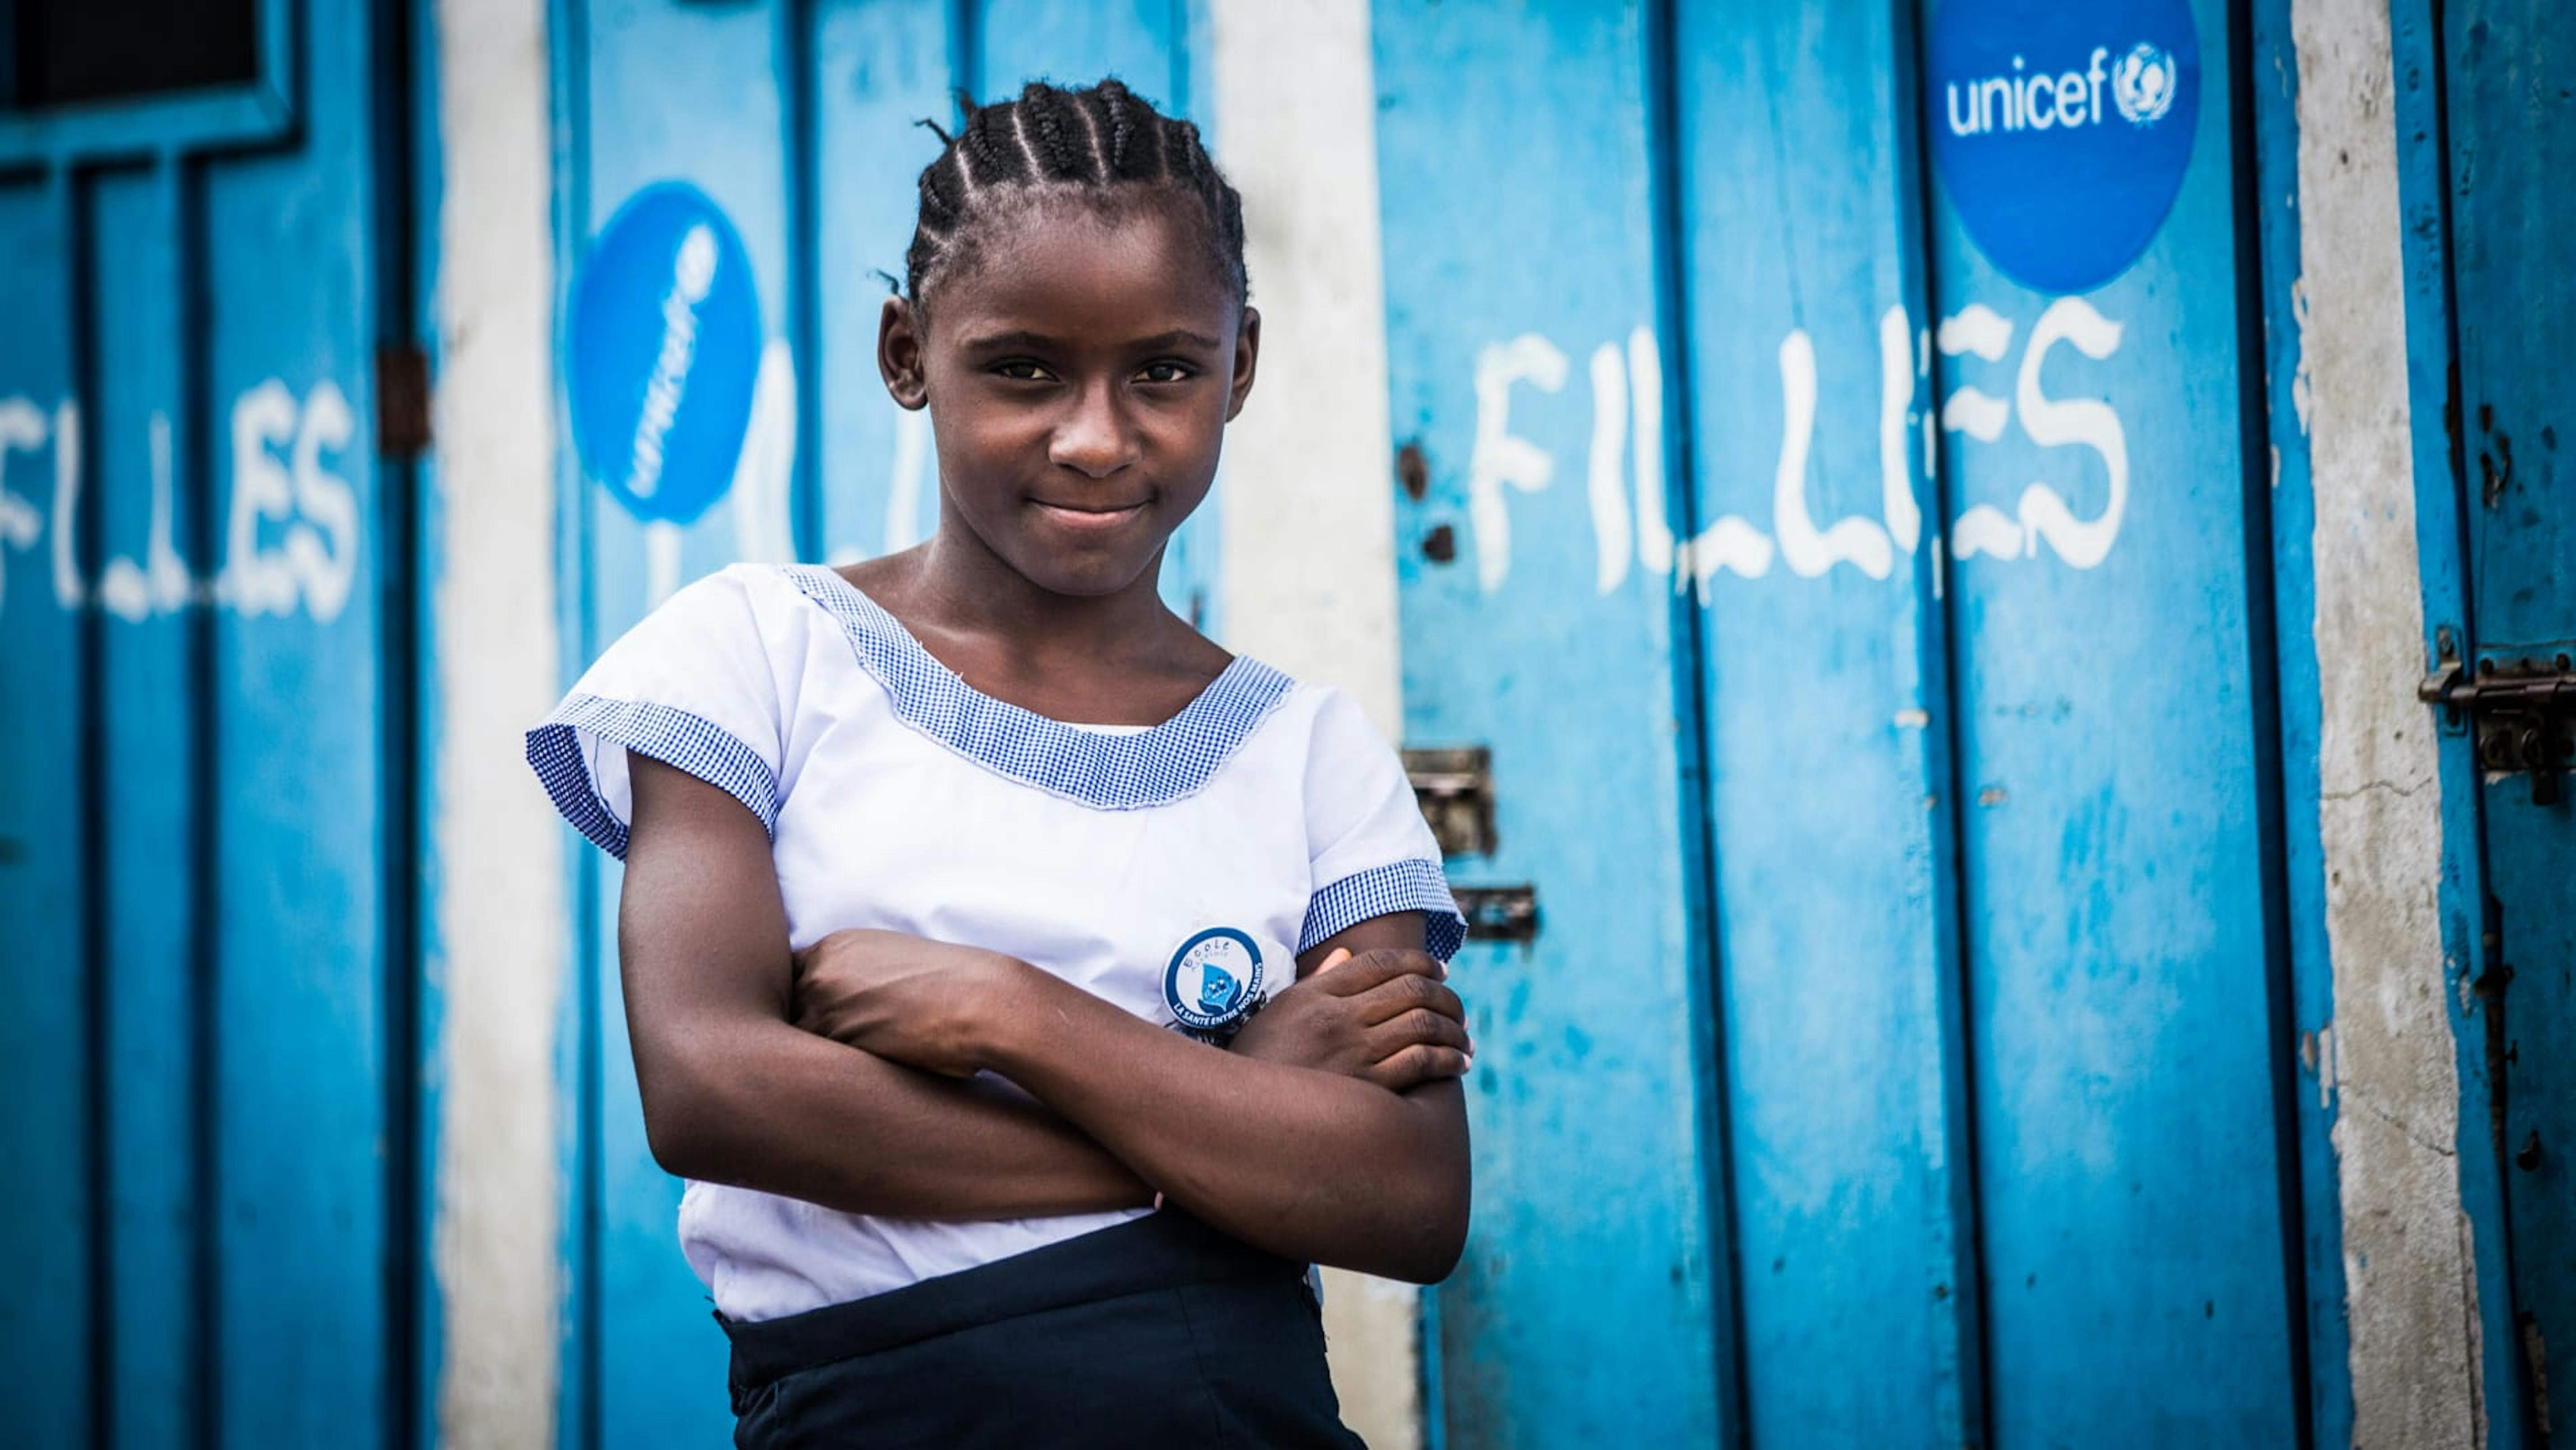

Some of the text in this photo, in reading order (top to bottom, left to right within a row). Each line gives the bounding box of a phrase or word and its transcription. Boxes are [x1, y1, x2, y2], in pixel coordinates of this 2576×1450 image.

[1946, 47, 2108, 136] unicef
[1469, 295, 2129, 609] FILLES
[1173, 1003, 1184, 1017] LA
[1211, 1009, 1238, 1025] ENTRE
[1238, 992, 1255, 1010] NOS
[1250, 962, 1263, 993] MAINS
